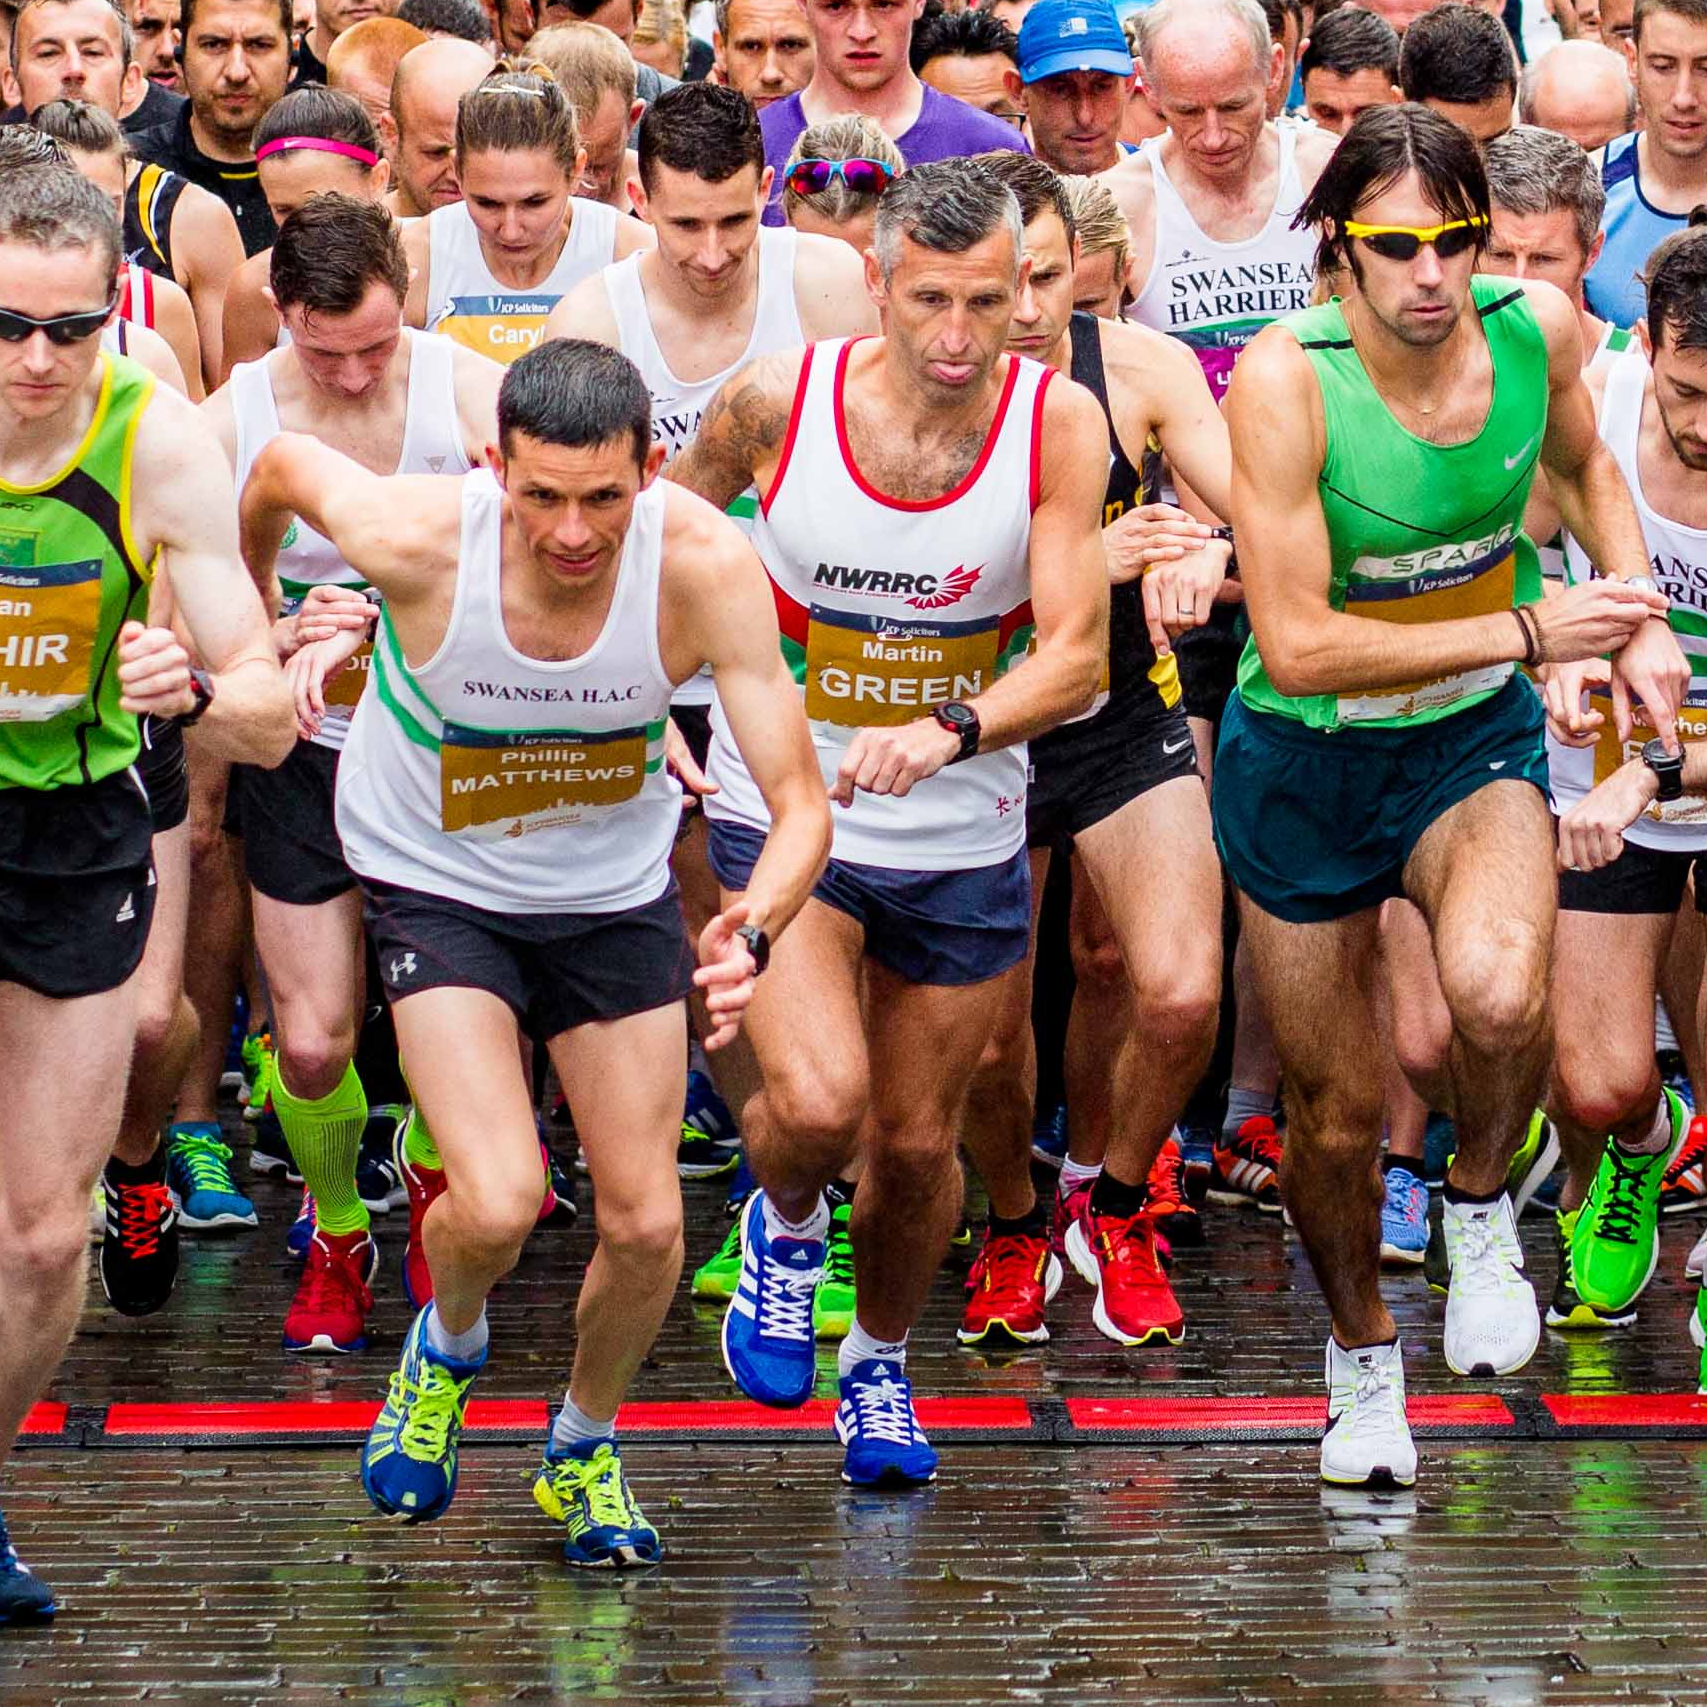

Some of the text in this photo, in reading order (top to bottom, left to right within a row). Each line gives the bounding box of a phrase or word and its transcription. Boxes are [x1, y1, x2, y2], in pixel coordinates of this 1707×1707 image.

[1171, 262, 1312, 297] SWANSEA
[1167, 288, 1312, 325] HARRIER
[813, 562, 939, 595] NWRRC
[862, 640, 943, 663] Martin
[463, 680, 642, 703] SWANSEA H.A.C
[818, 668, 982, 706] GREEN
[501, 749, 588, 764] Phillip
[451, 765, 636, 795] MATTHEWS
